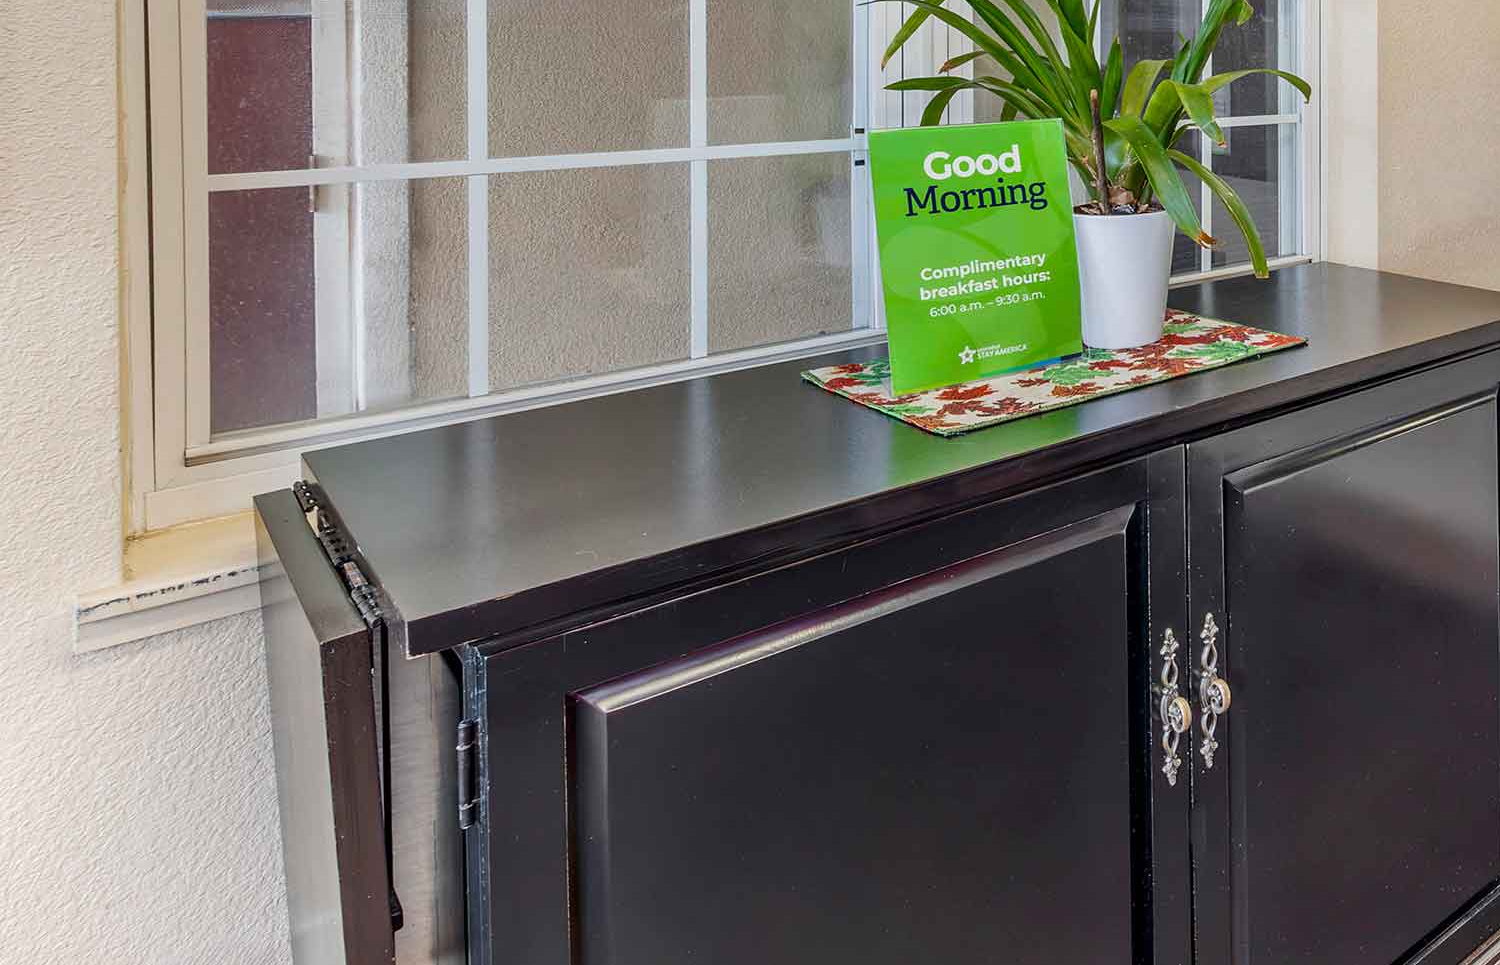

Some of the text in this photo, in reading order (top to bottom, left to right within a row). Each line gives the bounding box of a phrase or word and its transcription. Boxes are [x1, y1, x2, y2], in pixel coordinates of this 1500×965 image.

[923, 143, 1022, 181] Good
[903, 177, 1049, 217] Morning
[920, 252, 1047, 281] Complimentary
[920, 270, 1051, 301] breakfast hours:
[929, 304, 957, 317] 6:00
[959, 300, 985, 313] a.m.
[995, 293, 1020, 307] 9:30
[1022, 290, 1046, 302] a.m.
